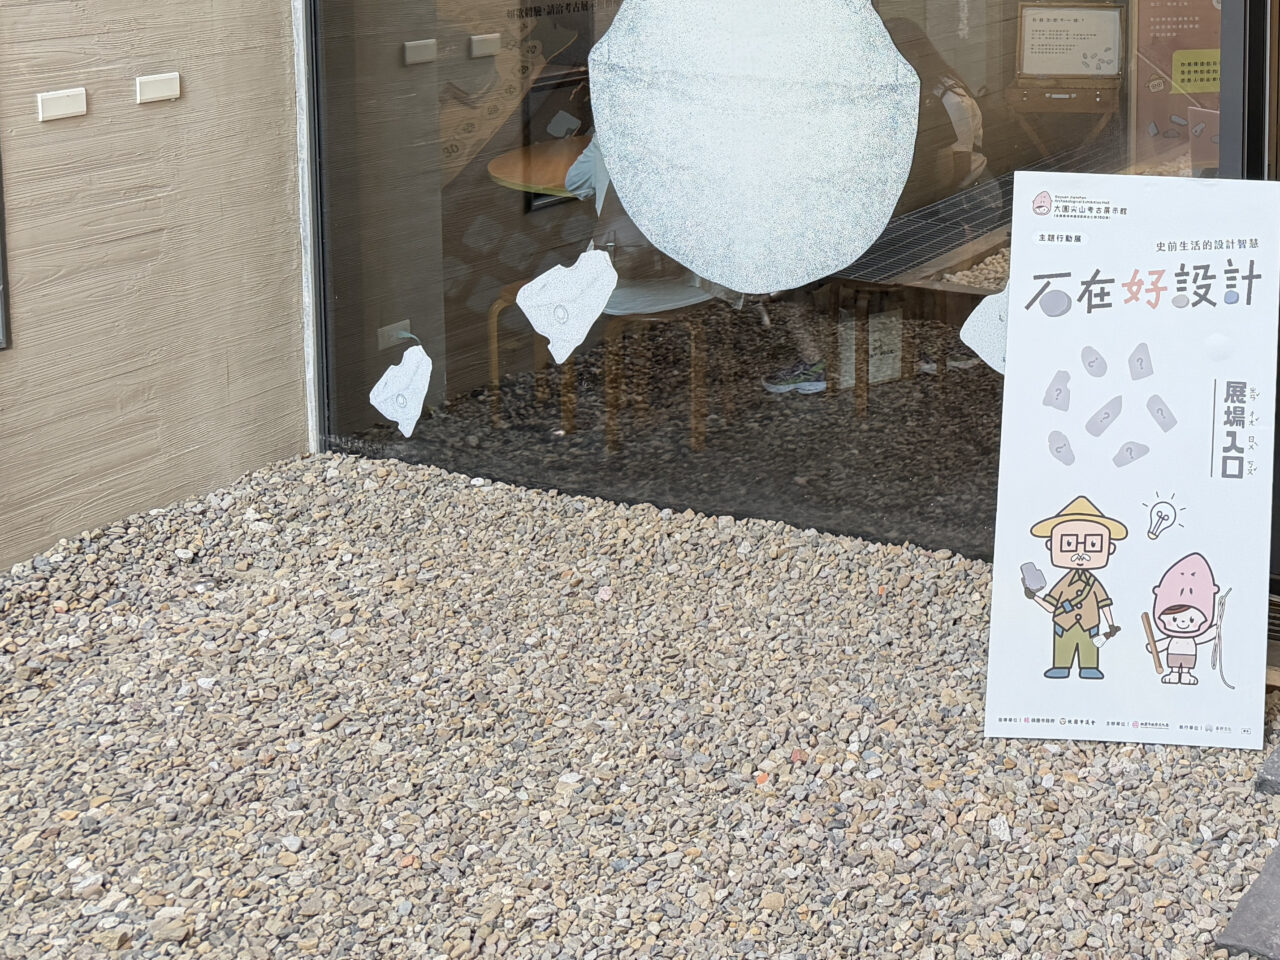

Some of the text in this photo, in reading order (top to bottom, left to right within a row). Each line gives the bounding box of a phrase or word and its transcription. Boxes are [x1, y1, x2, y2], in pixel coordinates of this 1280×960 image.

[1054, 205, 1127, 215] 大園尖山考古展示館
[1038, 233, 1082, 243] 主題行動展
[1156, 238, 1259, 252] 史前生活的設計智慧
[1025, 258, 1262, 317] 石在好設計
[1221, 380, 1247, 479] 展場入口
